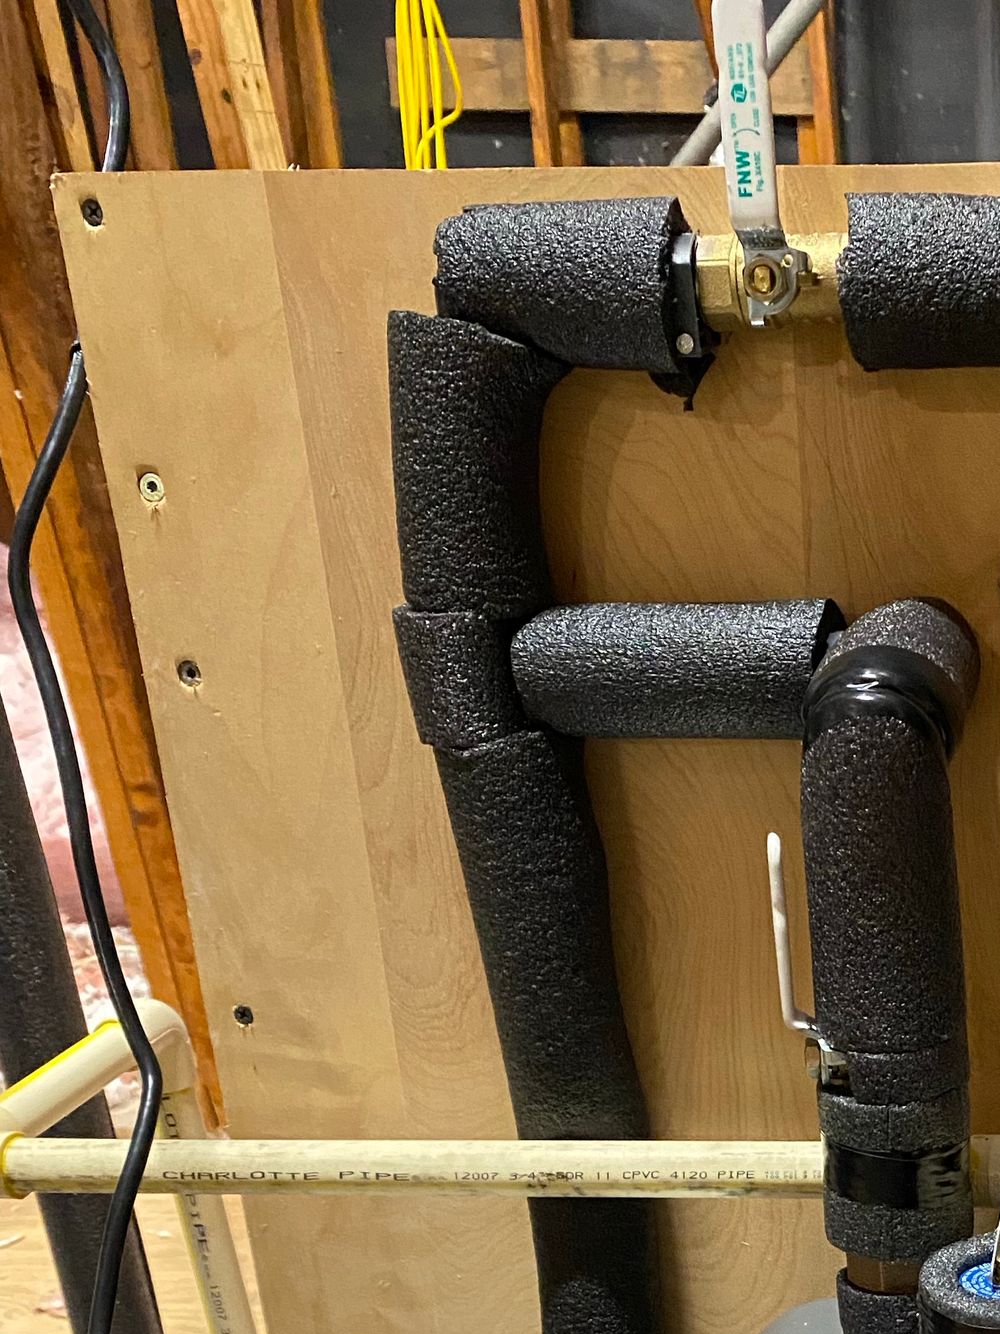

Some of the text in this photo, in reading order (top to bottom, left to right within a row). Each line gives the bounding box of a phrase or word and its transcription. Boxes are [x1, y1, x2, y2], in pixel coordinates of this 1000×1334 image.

[162, 1170, 320, 1181] CHARLOTTE
[338, 1170, 411, 1182] PIPE
[454, 1171, 498, 1181] 12007
[622, 1170, 661, 1180] CPVC
[669, 1170, 709, 1180] 4120
[717, 1170, 756, 1180] PIPE
[185, 1194, 210, 1253] PIPE
